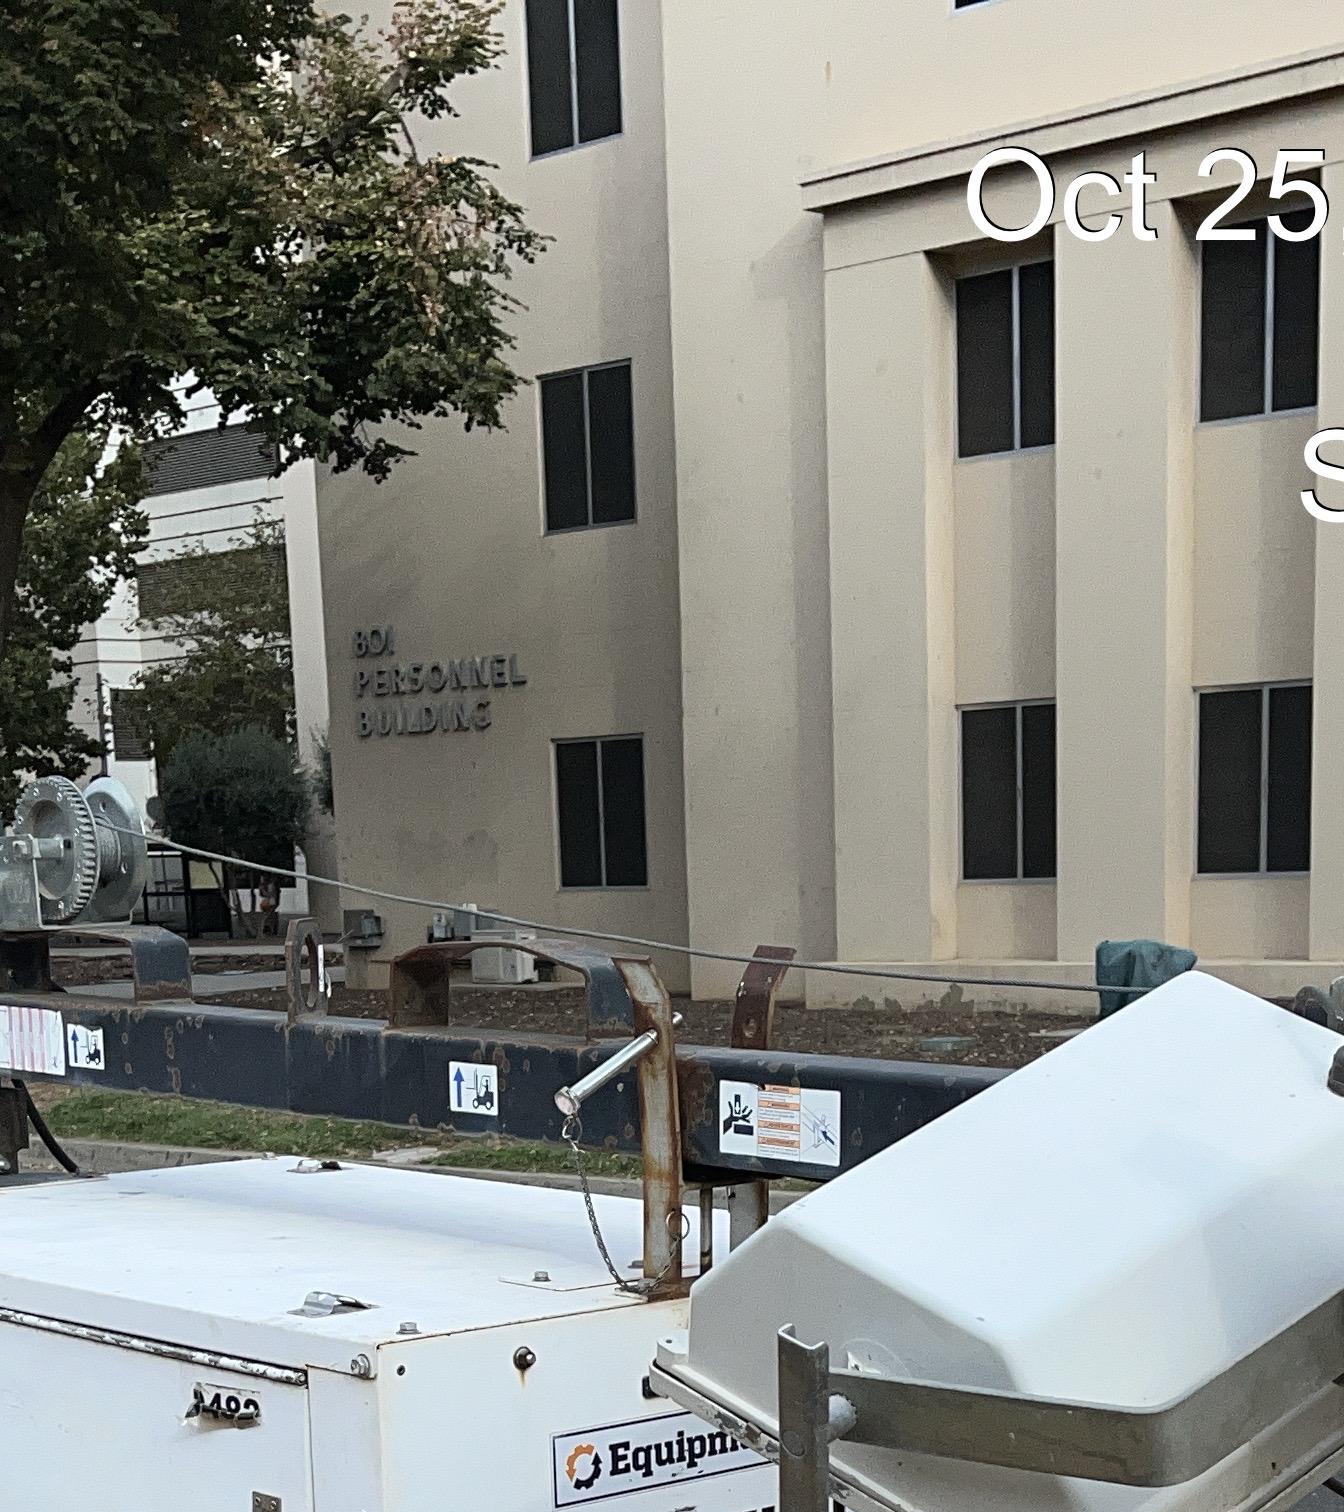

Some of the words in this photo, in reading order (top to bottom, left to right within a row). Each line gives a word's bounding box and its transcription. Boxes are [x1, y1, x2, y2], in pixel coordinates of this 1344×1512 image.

[355, 654, 528, 697] PERSONNEL
[357, 699, 492, 738] BUILDING
[608, 1430, 750, 1478] Equipm
